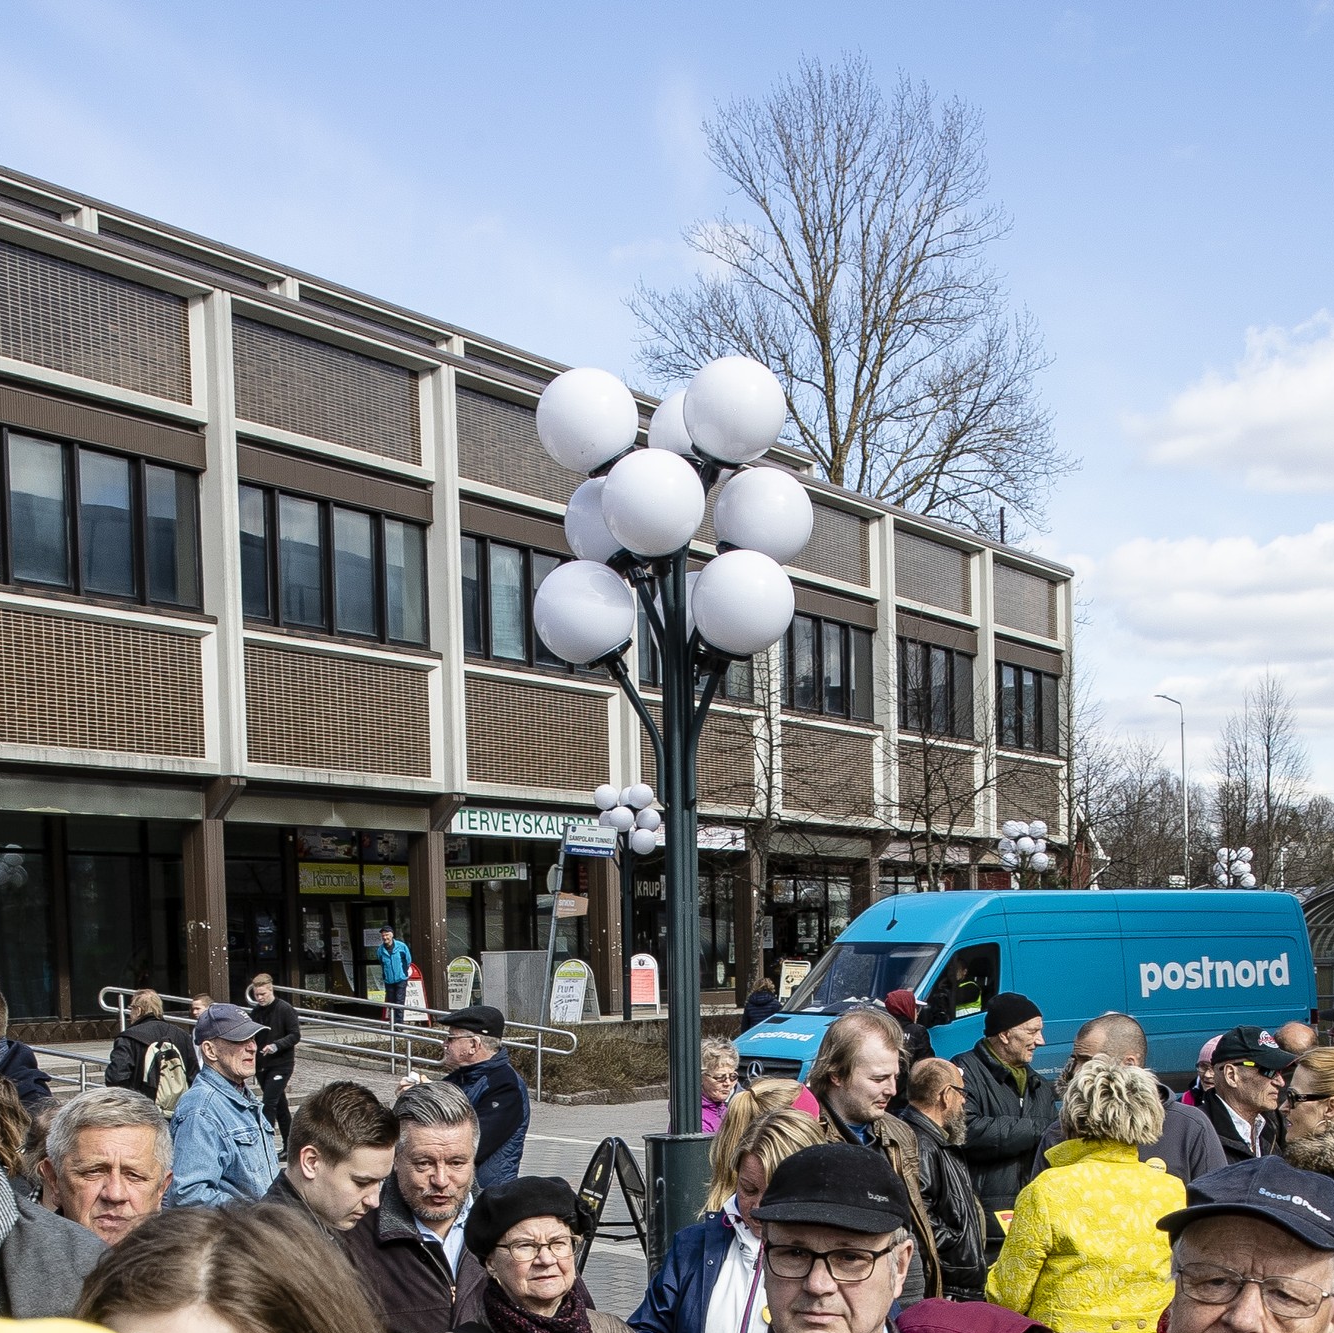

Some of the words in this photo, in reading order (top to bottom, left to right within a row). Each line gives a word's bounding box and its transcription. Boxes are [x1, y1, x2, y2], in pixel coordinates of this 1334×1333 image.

[312, 871, 359, 889] Kamomilla
[445, 865, 517, 881] RVEYSKAUPPA
[1139, 952, 1290, 998] postnord
[749, 1031, 815, 1041] postnord
